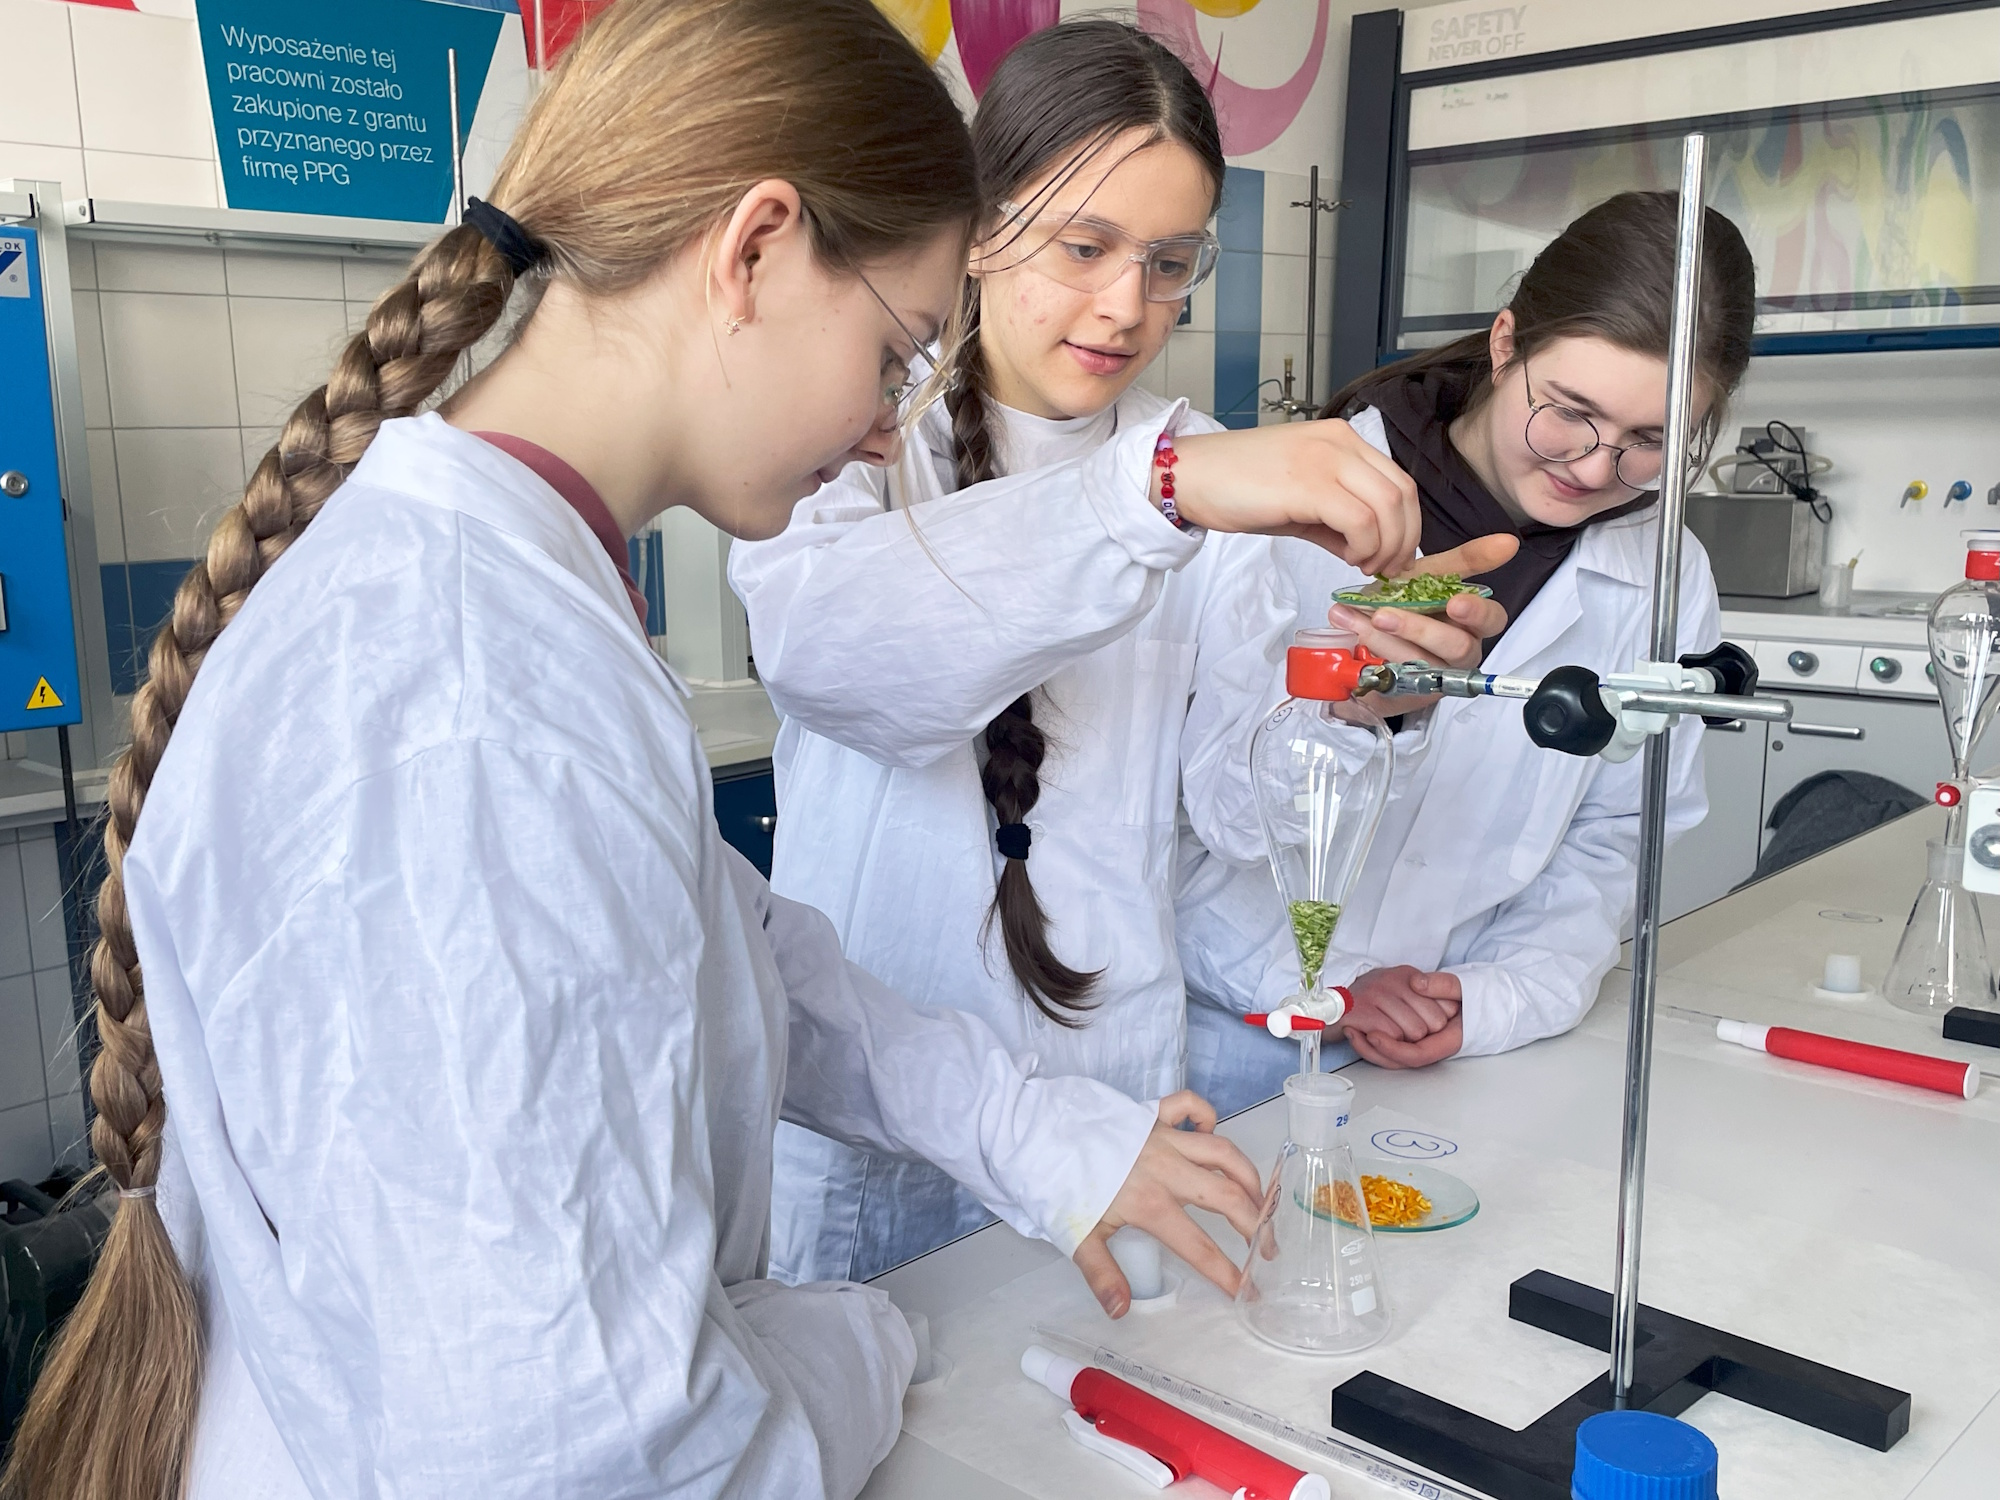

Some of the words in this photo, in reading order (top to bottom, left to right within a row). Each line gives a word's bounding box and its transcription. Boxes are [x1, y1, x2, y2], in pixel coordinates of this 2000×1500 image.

[1430, 5, 1527, 43] SAFETY
[220, 24, 367, 66] Wyposażenie
[371, 48, 397, 74] tej
[1428, 39, 1482, 62] NEVER
[1486, 32, 1526, 56] OFF
[227, 60, 325, 90] pracowni
[331, 74, 403, 101] zostało
[231, 93, 342, 124] zakupione
[347, 108, 360, 126] z
[364, 109, 427, 134] grantu
[237, 126, 374, 160] przyznanego
[380, 140, 434, 164] przez
[242, 155, 298, 186] firmę
[304, 160, 350, 185] PPG
[0, 241, 21, 252] OK
